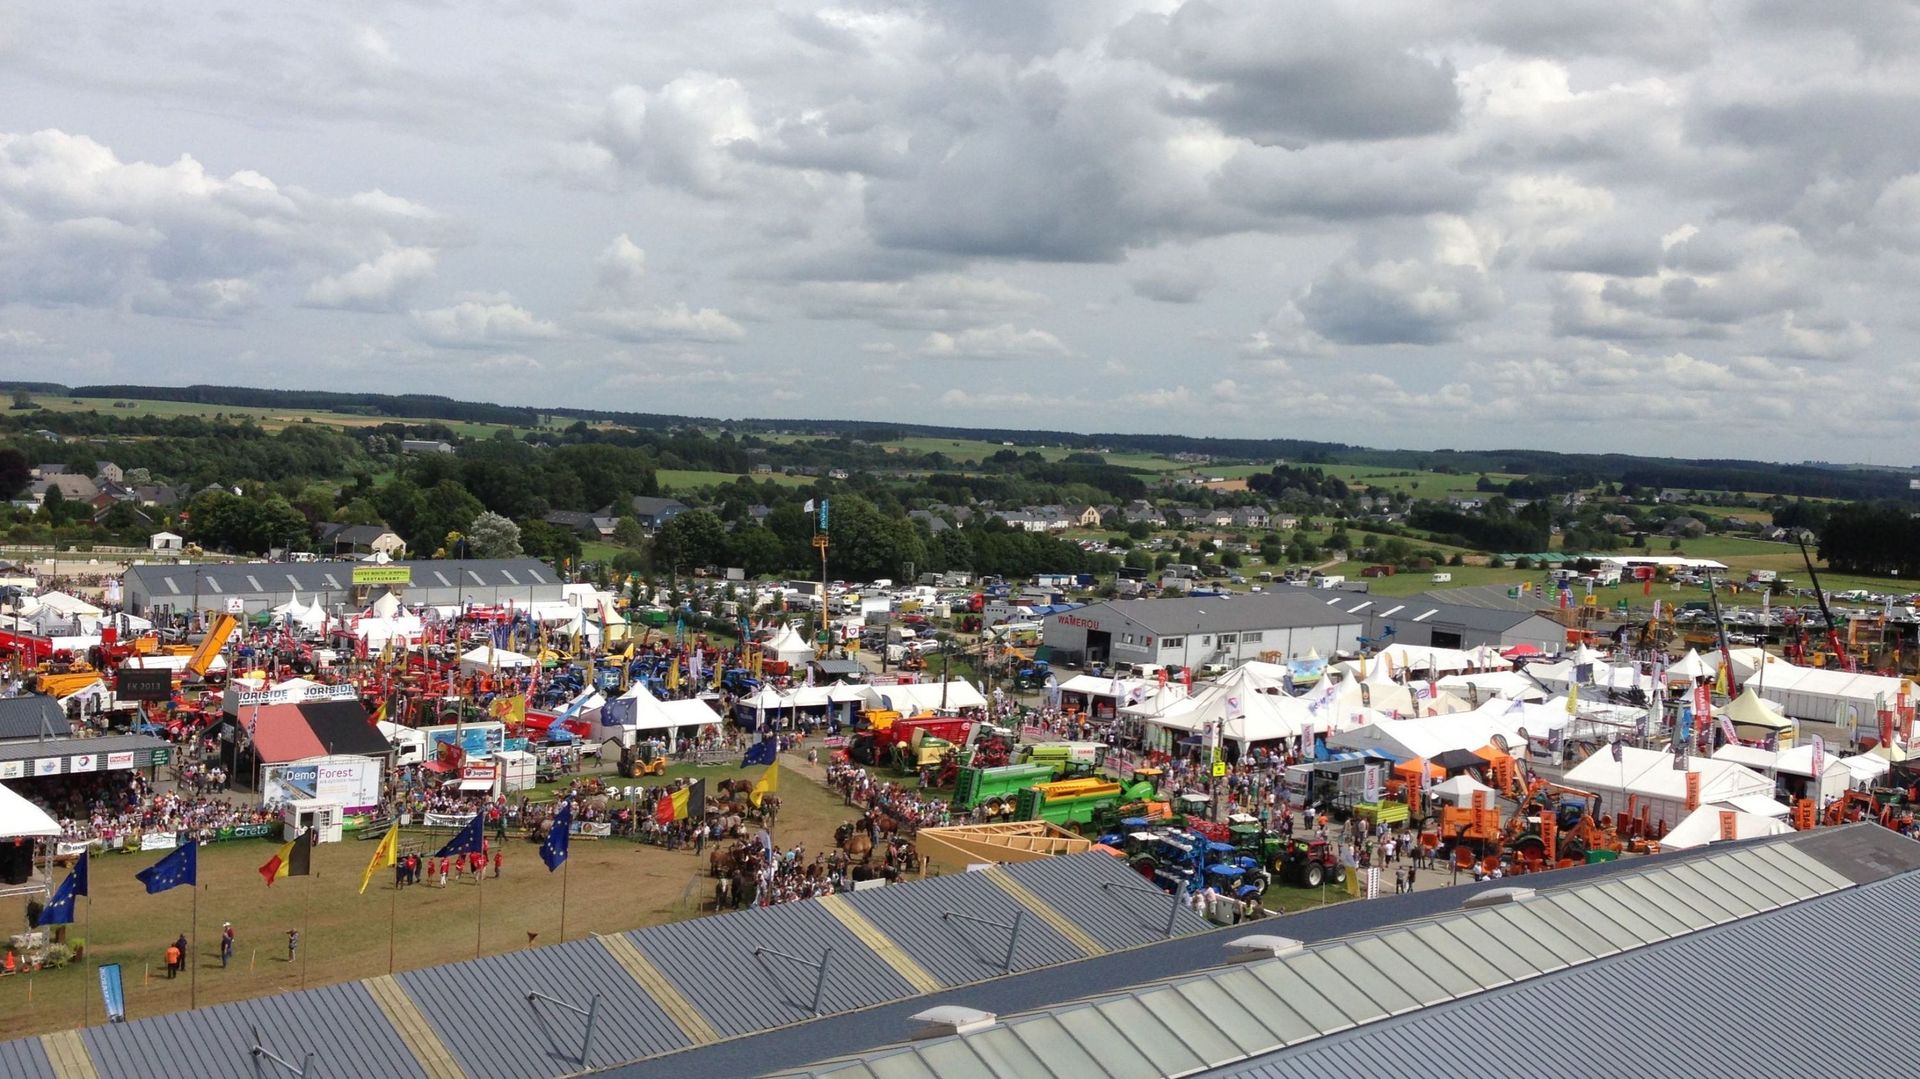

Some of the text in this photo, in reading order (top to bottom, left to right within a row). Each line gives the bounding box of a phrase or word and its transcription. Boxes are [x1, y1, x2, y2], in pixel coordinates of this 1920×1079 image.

[1057, 615, 1100, 630] WAMEROU
[286, 769, 316, 781] Demo
[319, 768, 353, 779] Forest
